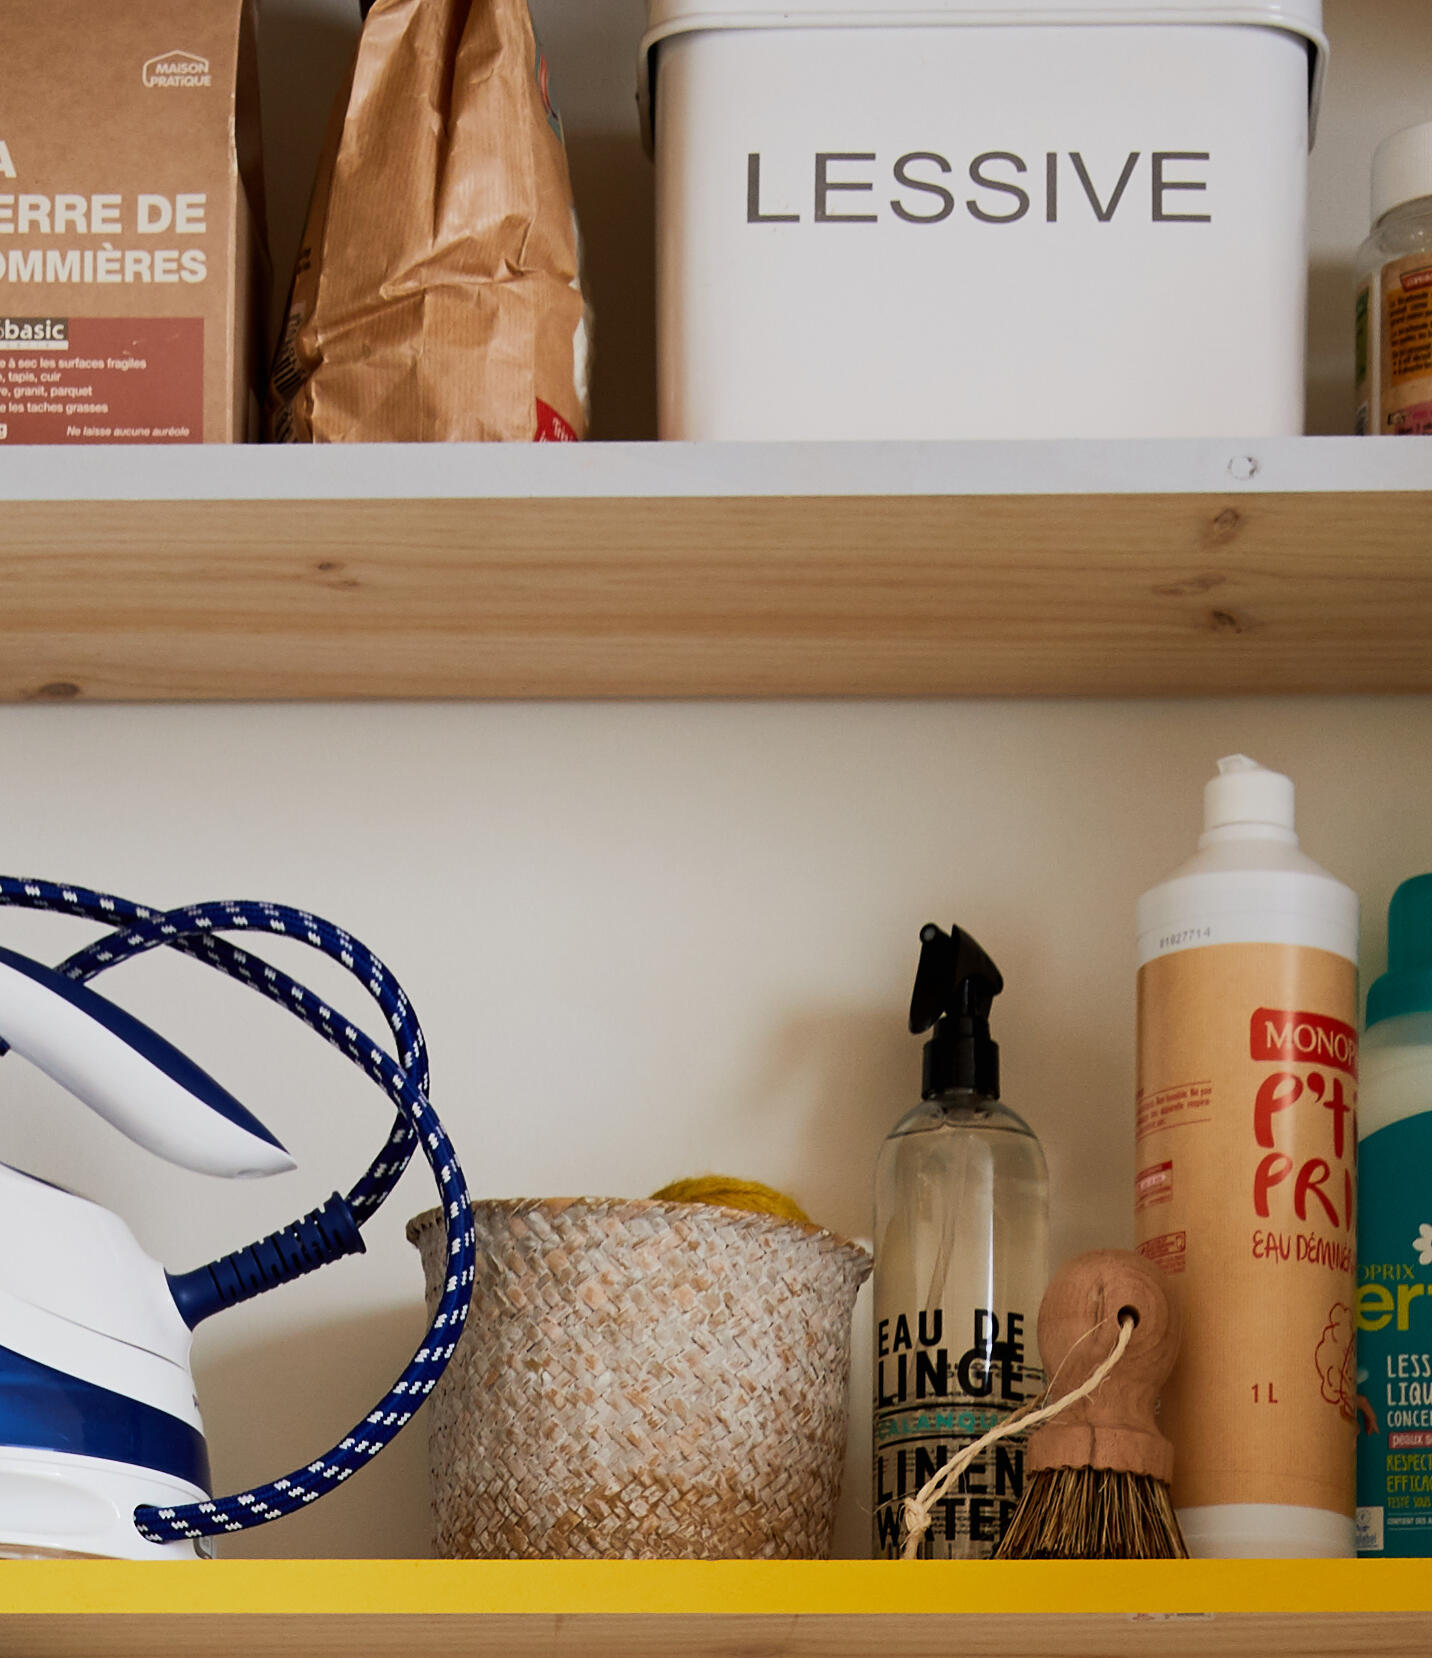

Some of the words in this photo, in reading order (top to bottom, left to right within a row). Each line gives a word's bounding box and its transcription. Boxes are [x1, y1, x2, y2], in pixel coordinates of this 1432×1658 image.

[155, 62, 209, 75] MAISON
[150, 74, 211, 88] PRATIQUE
[746, 151, 1212, 225] LESSIVE
[136, 193, 207, 234] DE
[8, 358, 16, 369] à
[18, 360, 37, 369] sec
[40, 358, 56, 369] les
[58, 358, 105, 369] surfaces
[107, 358, 147, 371] fragiles
[8, 372, 38, 385] tapis,
[40, 373, 62, 382] cuir
[13, 386, 48, 398] granit,
[50, 386, 93, 398] parquet
[8, 402, 25, 413] les
[27, 402, 64, 413] taches
[65, 404, 109, 415] grasses
[66, 426, 81, 437] Ne
[83, 426, 112, 437] laisse
[113, 427, 151, 437] aucune
[1252, 1230, 1291, 1264] EAU
[1356, 1264, 1416, 1281] OPRIX
[878, 1309, 943, 1358] EAU
[974, 1309, 1024, 1352] DE
[878, 1348, 1024, 1409] LINGE
[1251, 1383, 1259, 1404] 1
[1268, 1383, 1278, 1404] L
[1392, 1433, 1423, 1448] peaux
[878, 1445, 1023, 1507] LINEN
